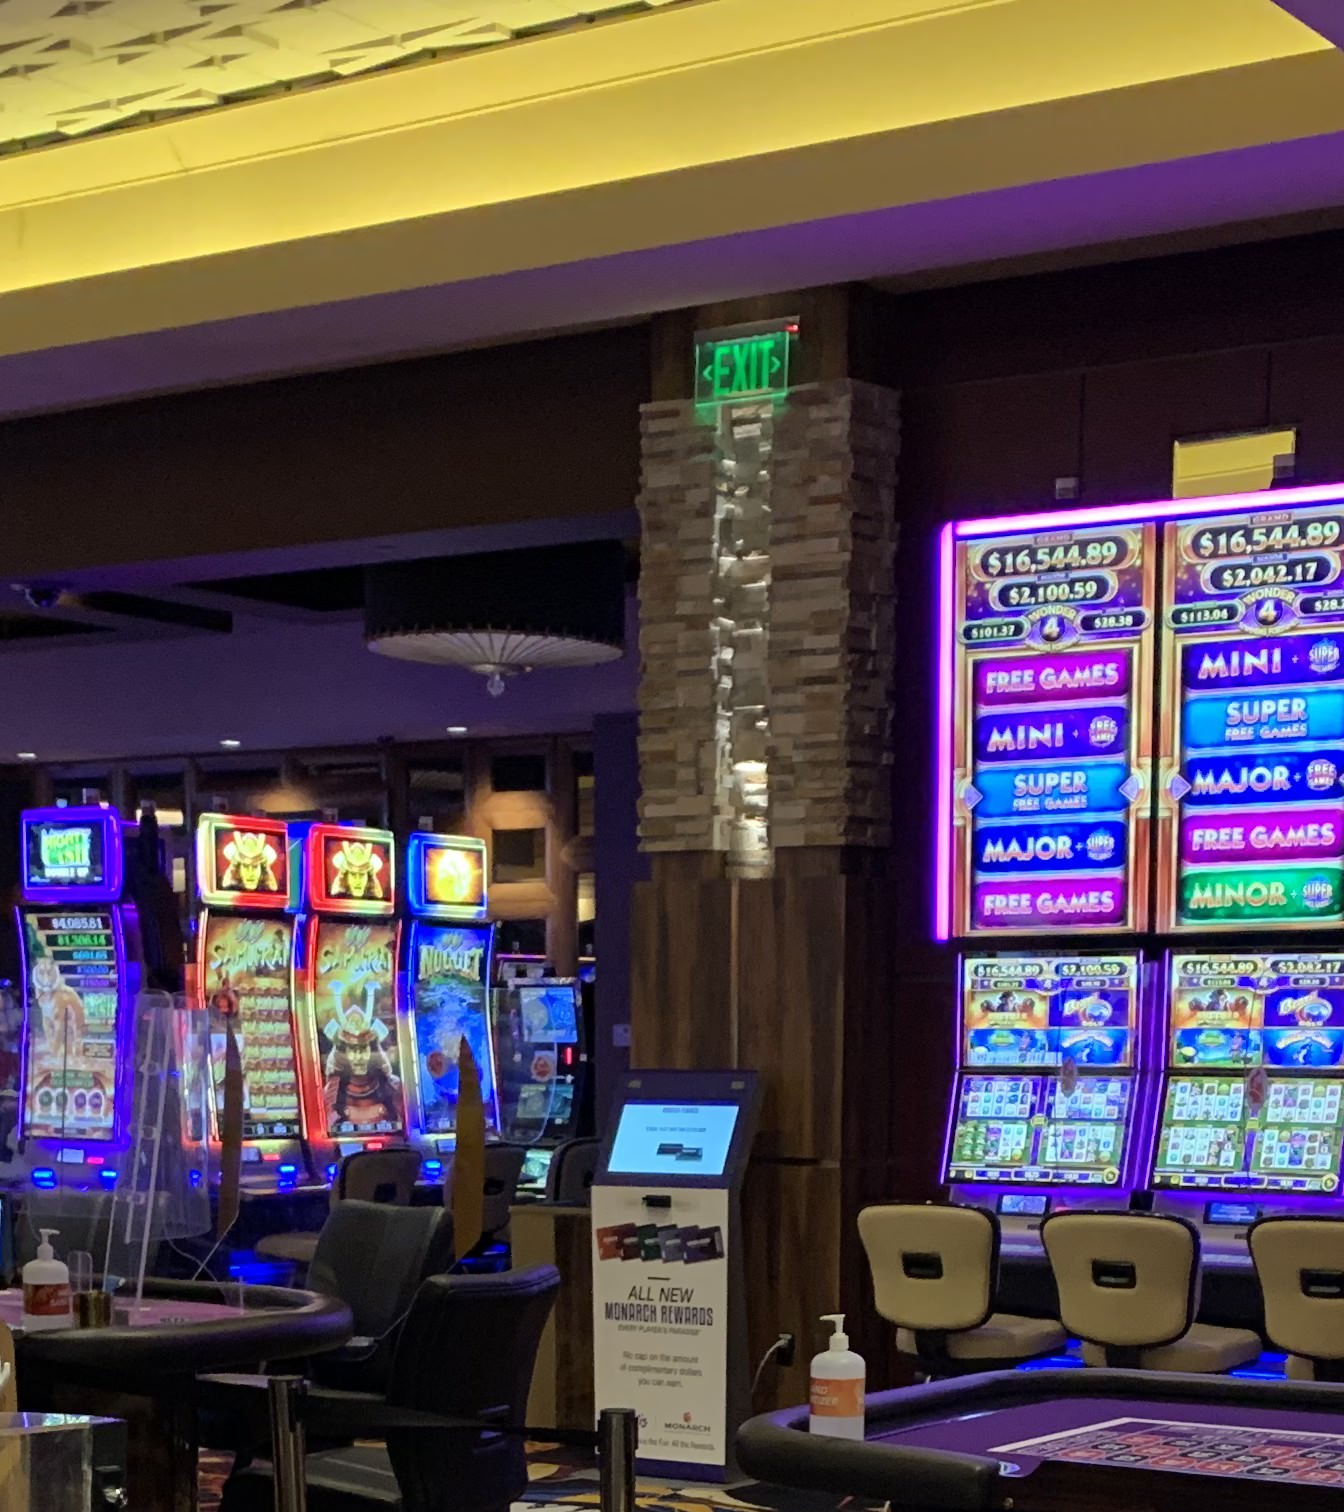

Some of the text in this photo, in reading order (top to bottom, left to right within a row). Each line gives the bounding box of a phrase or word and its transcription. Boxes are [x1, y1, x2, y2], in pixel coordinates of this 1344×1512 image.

[714, 340, 775, 395] EXIT
[1200, 521, 1341, 556] $16,544.89
[988, 541, 1118, 576] $16,544.89
[1222, 562, 1318, 587] $2,042.17
[1009, 580, 1098, 605] $2,100.59
[1197, 647, 1282, 679] MINI
[986, 662, 1120, 694] FREE GAMES
[1226, 697, 1307, 725] SUPER
[987, 722, 1064, 752] MINI
[1014, 771, 1088, 797] SUPER
[1191, 765, 1291, 795] MAJOR
[982, 835, 1073, 863] MAJOR
[1191, 823, 1336, 851] FREE GAMES
[984, 890, 1115, 915] FREE GAMES
[1189, 881, 1287, 909] MINOR
[627, 1285, 695, 1304] ALL NEW
[604, 1302, 714, 1326] MONARCH REWARDS
